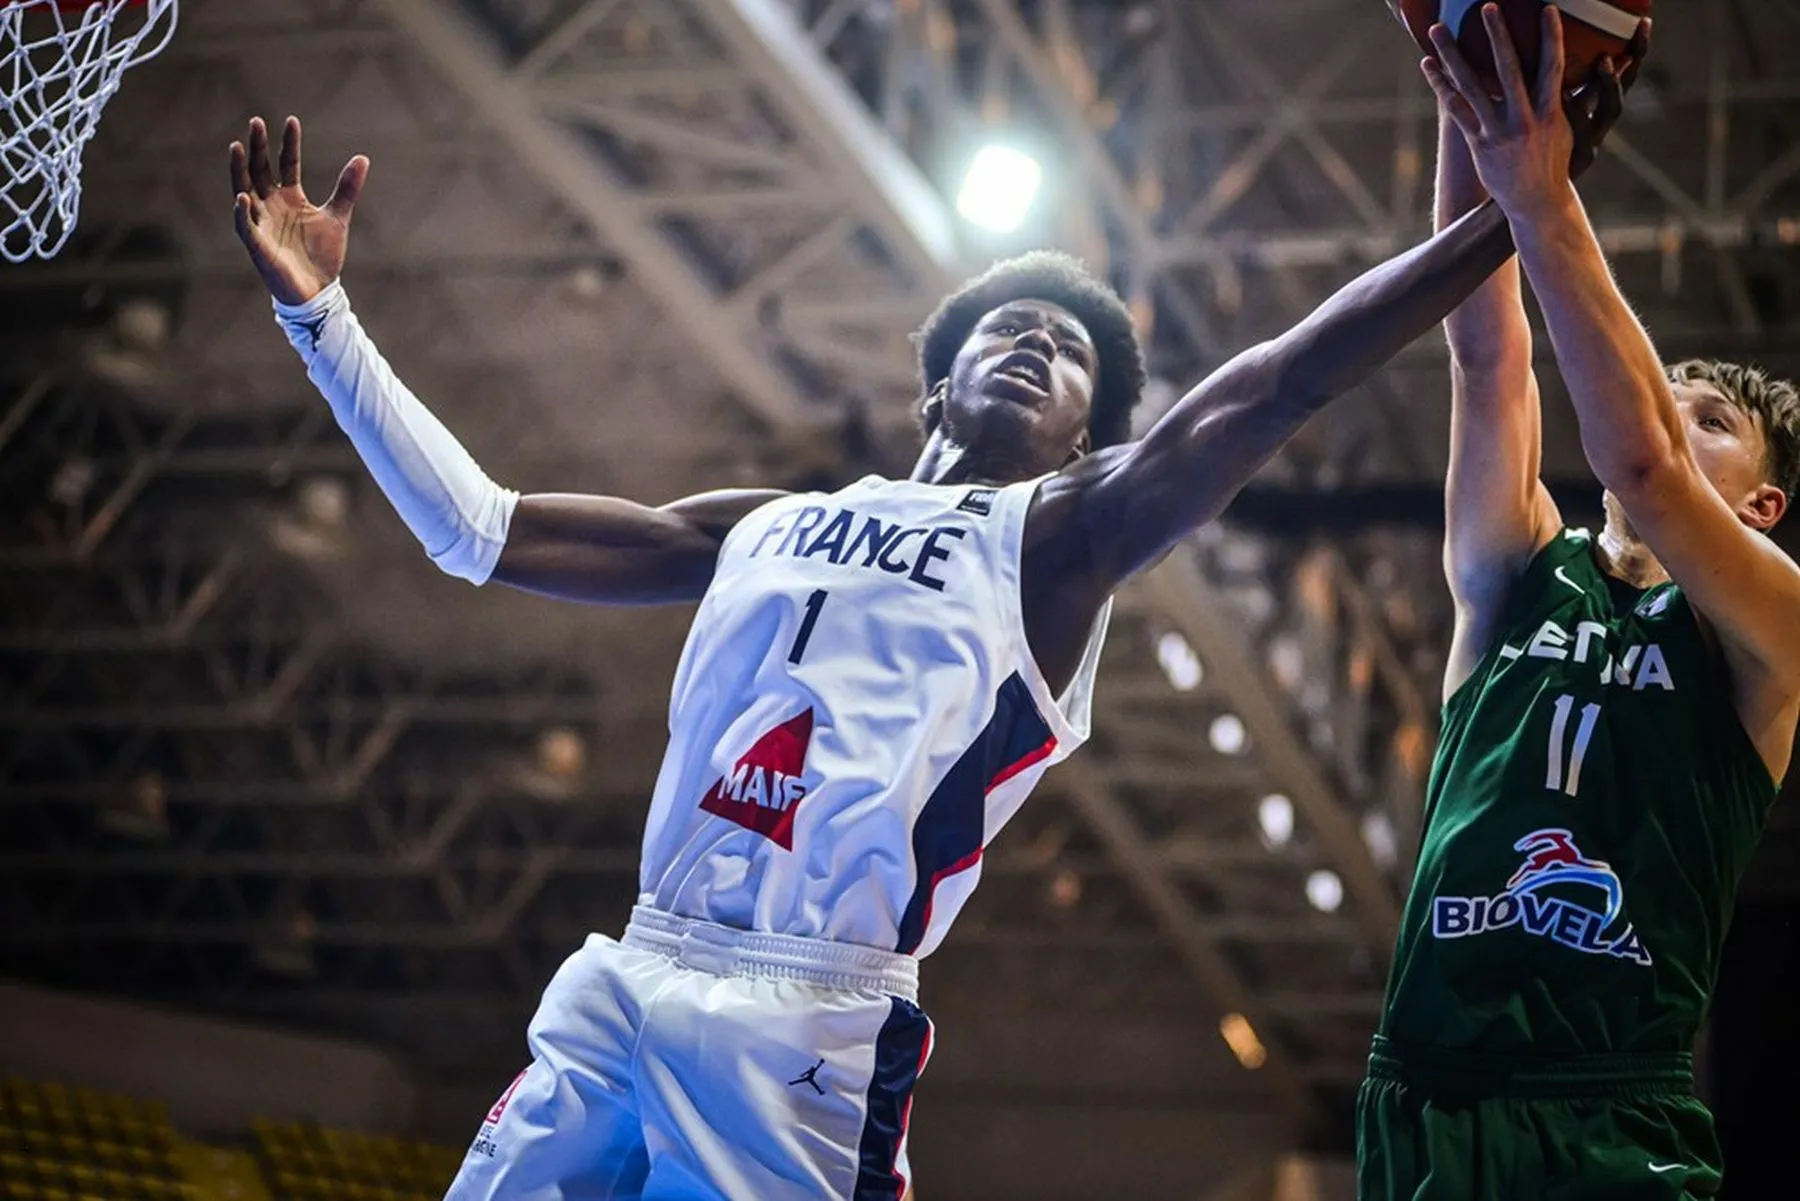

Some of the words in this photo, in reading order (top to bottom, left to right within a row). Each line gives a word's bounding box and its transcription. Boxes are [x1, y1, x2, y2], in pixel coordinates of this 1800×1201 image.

[749, 508, 966, 591] FRANCE
[787, 589, 829, 665] 1
[1545, 694, 1601, 796] 11
[717, 763, 806, 812] MAIF
[1433, 894, 1652, 965] BIOVELA
